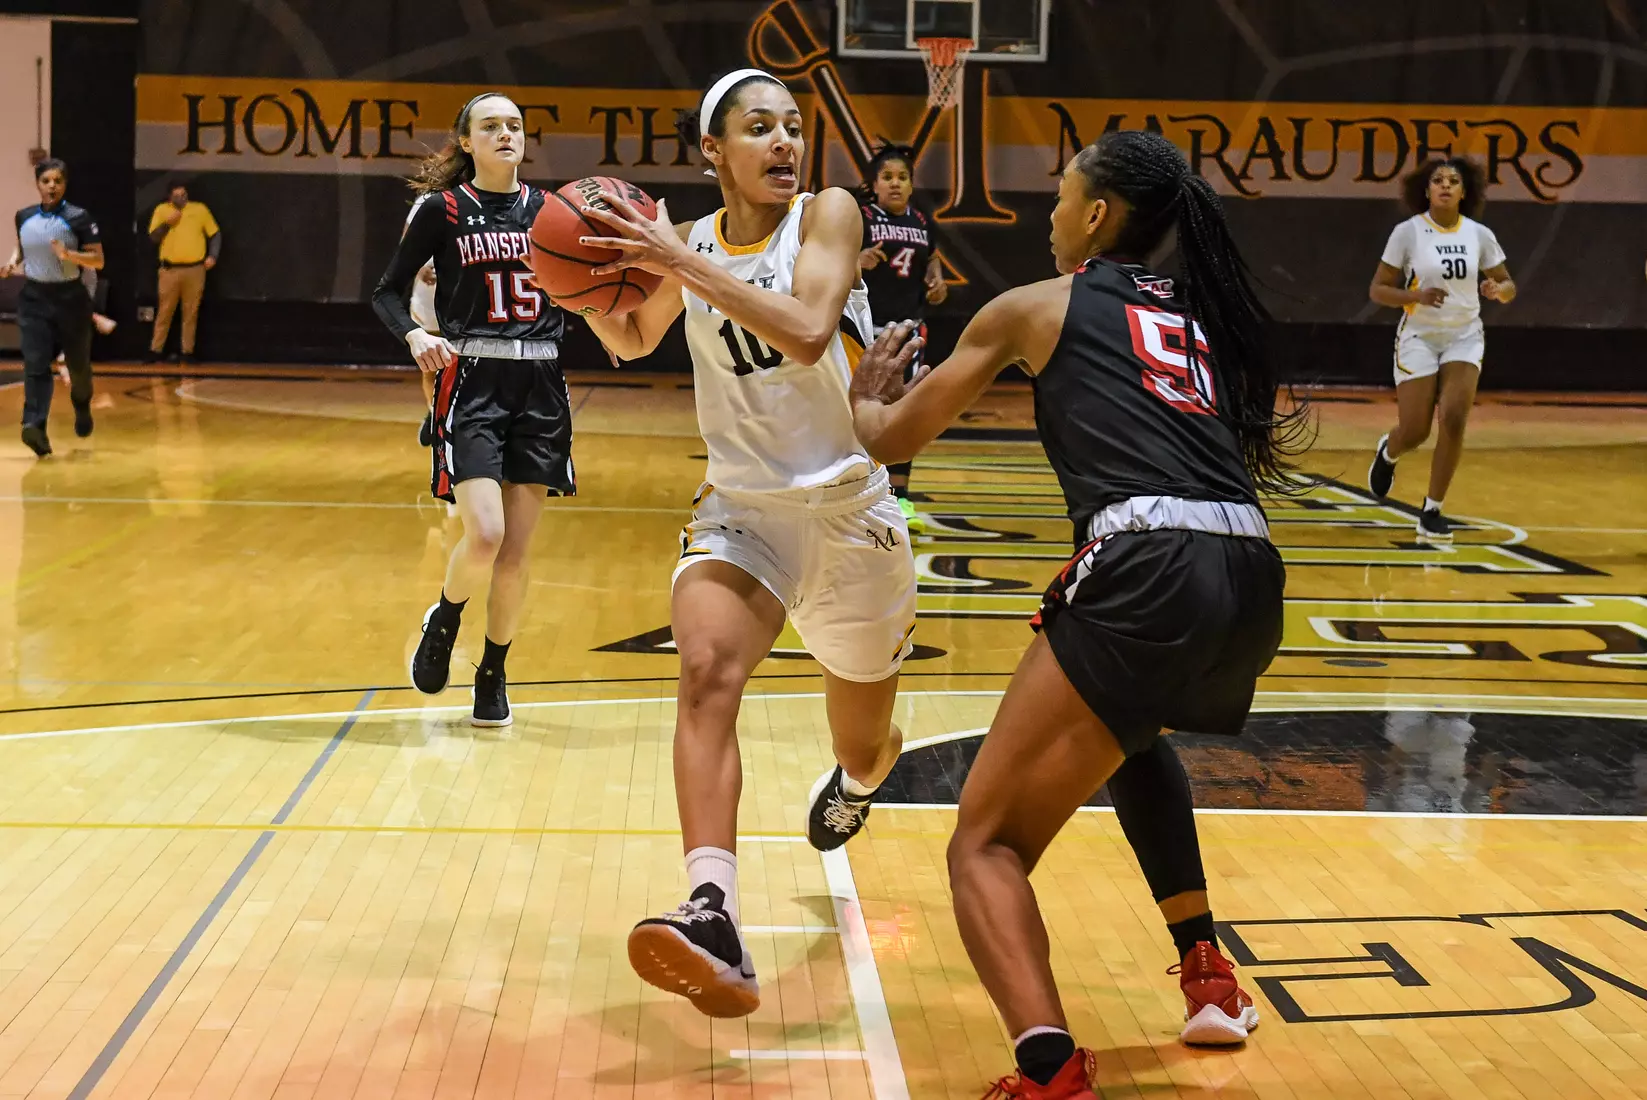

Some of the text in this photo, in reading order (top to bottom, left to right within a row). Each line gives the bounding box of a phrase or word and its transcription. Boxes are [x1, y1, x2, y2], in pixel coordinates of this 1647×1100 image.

[177, 88, 1584, 203] HOME F TH MRAUDERS
[456, 231, 531, 267] MANSFI
[889, 246, 916, 278] 4
[1435, 244, 1468, 256] VILLE
[1441, 257, 1467, 280] 30
[484, 270, 542, 323] 15
[718, 318, 784, 377] 10
[1124, 303, 1219, 417] 5
